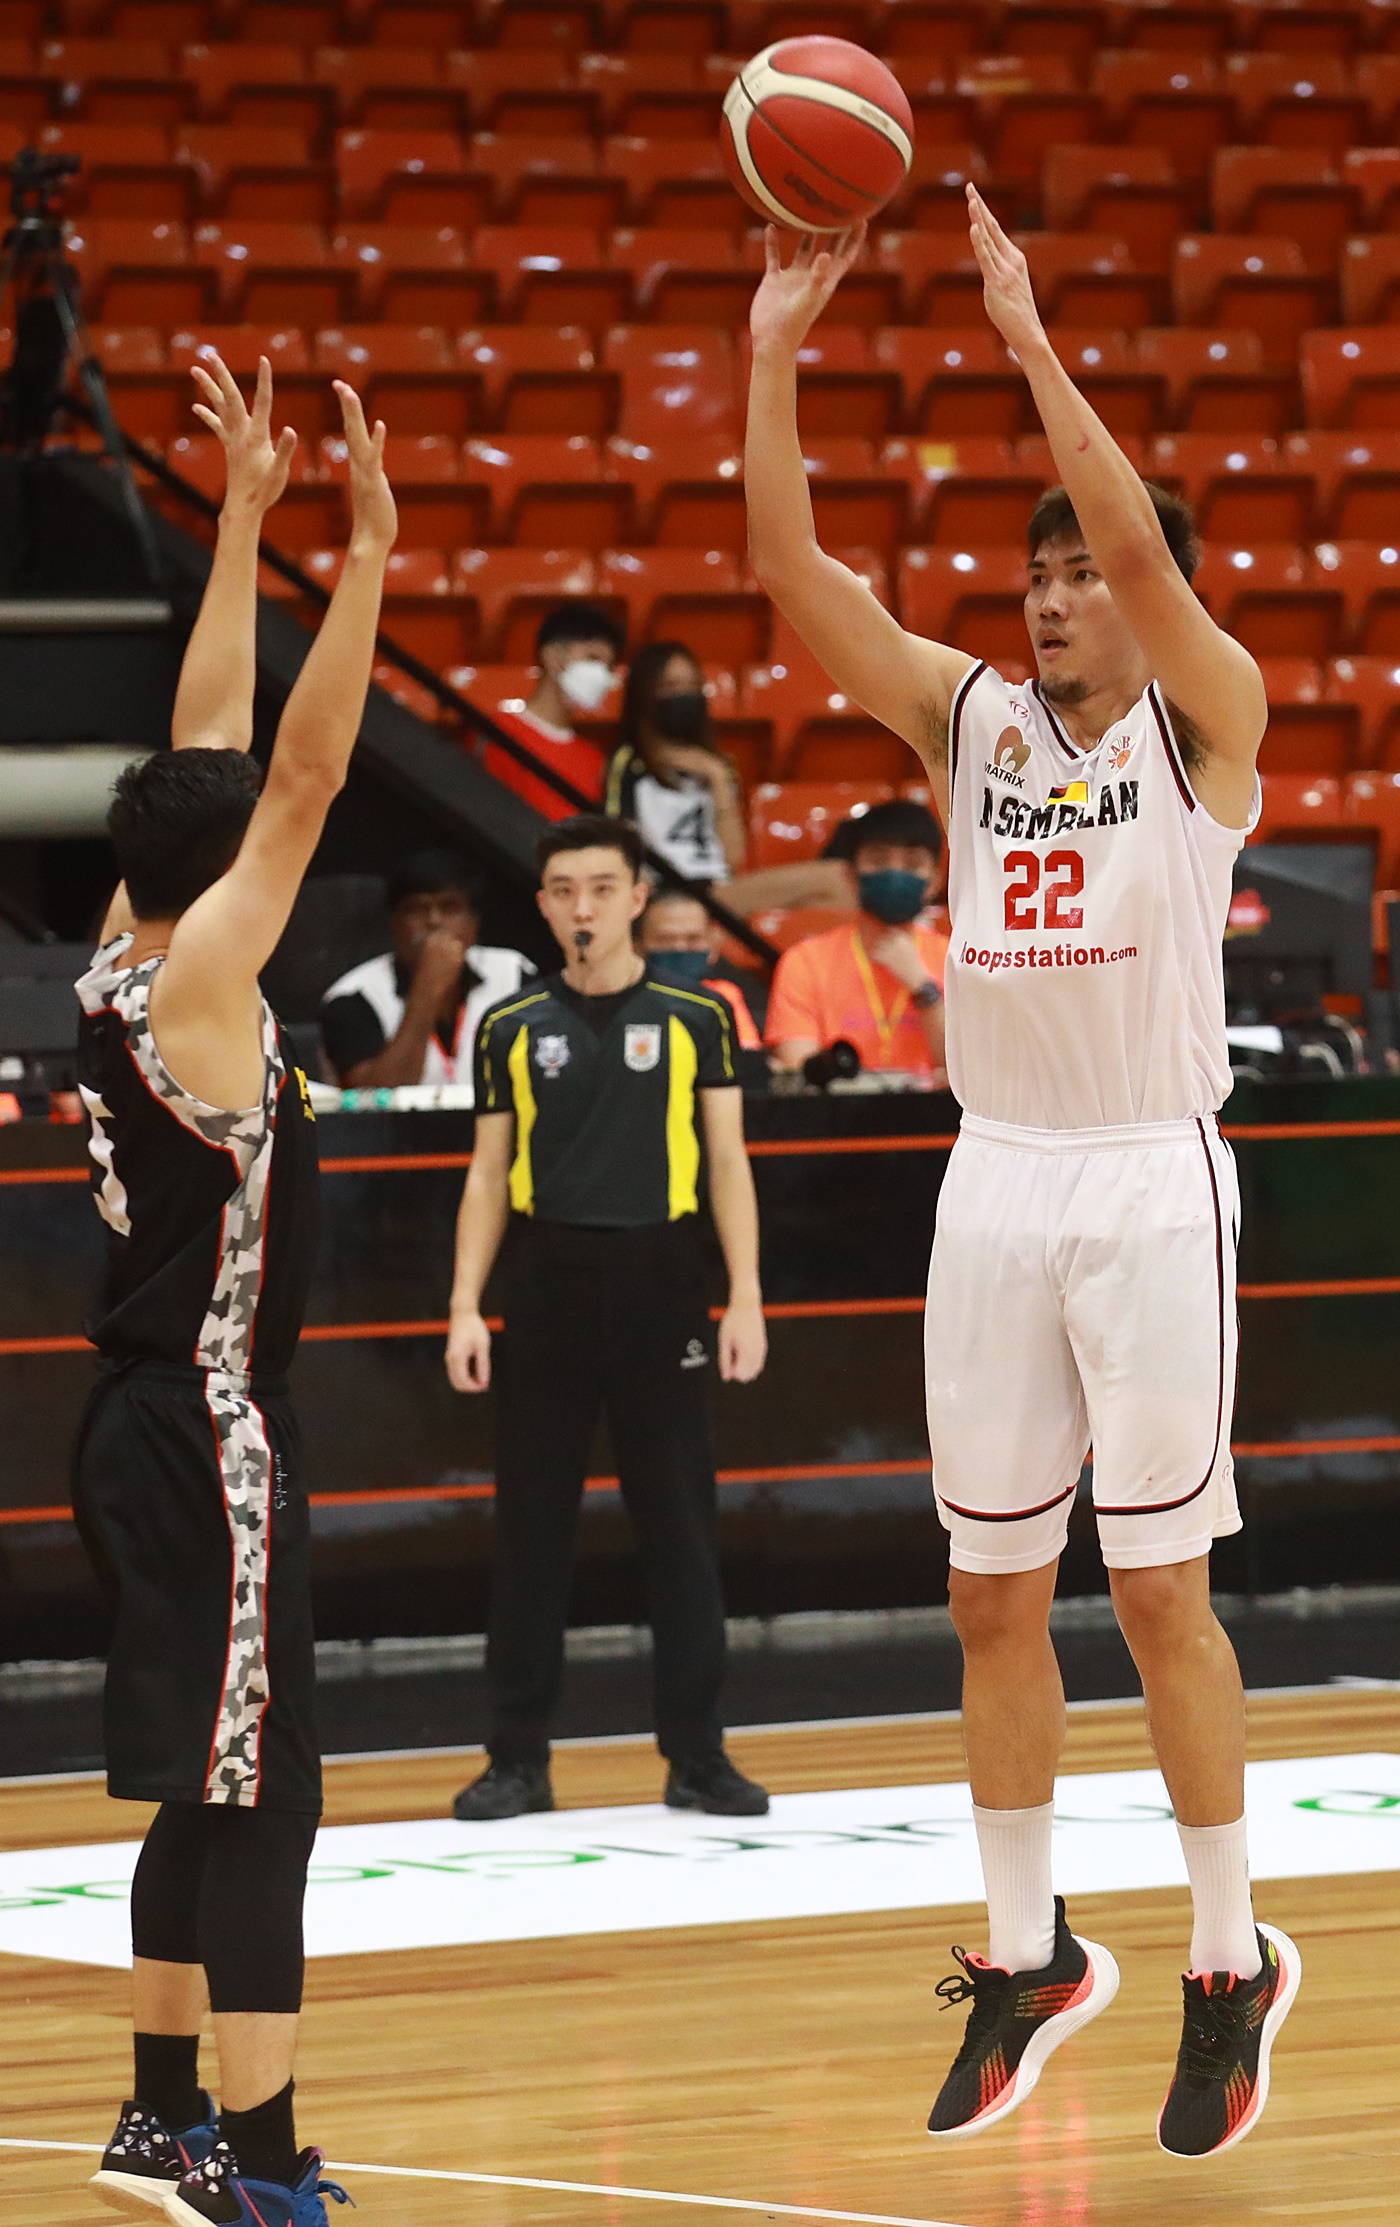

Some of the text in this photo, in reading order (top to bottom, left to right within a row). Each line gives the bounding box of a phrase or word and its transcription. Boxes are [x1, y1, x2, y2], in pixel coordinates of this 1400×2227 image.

[984, 761, 1026, 789] MATRIX
[1107, 735, 1136, 770] MAB
[667, 804, 711, 861] 4
[1003, 850, 1084, 931] 22
